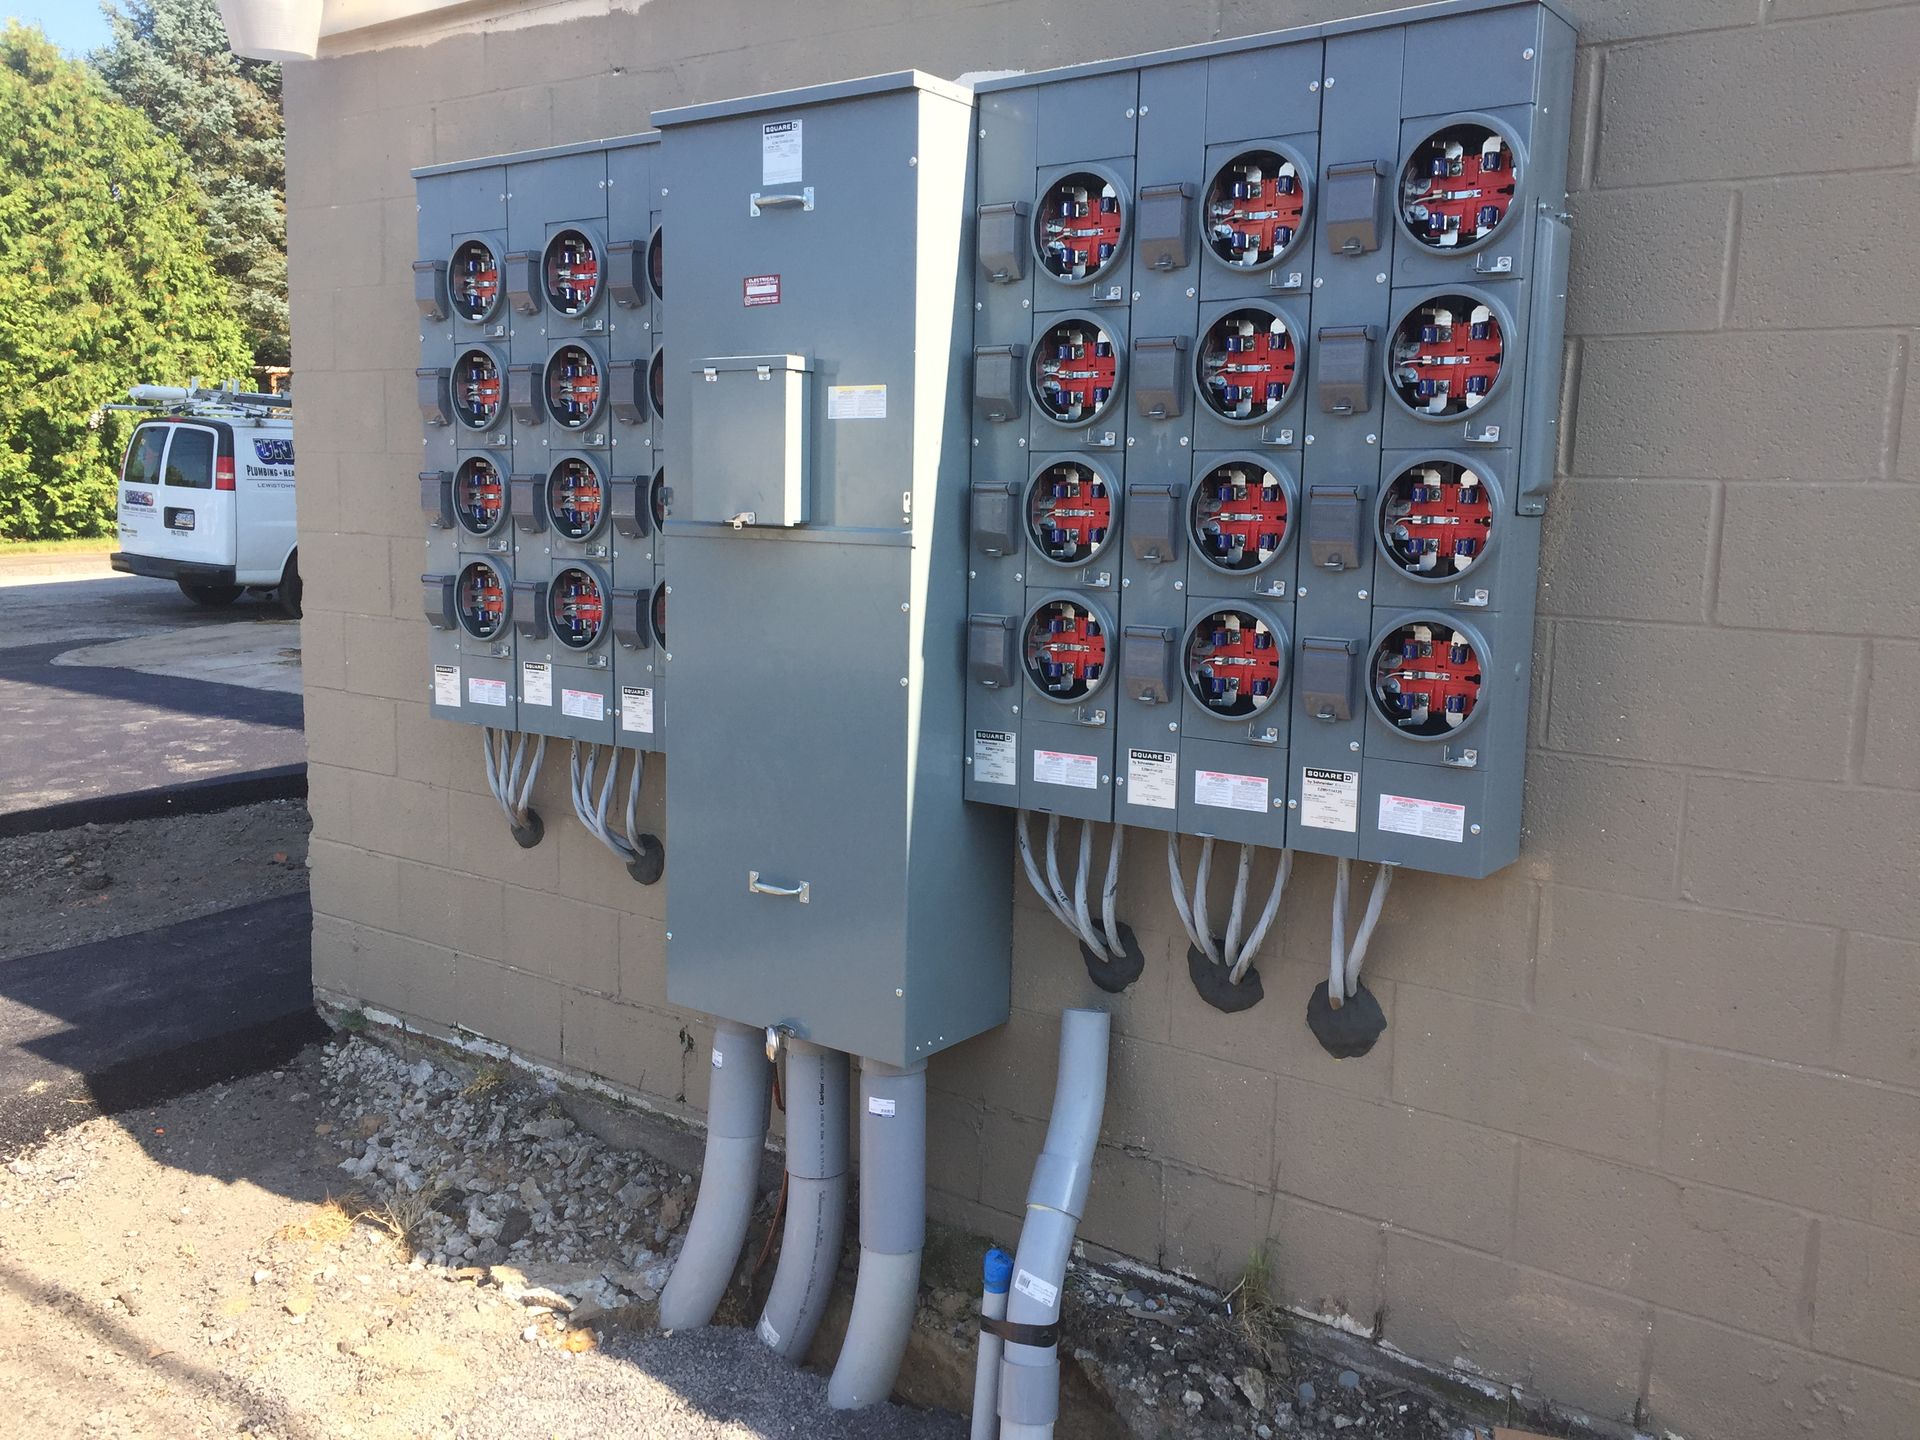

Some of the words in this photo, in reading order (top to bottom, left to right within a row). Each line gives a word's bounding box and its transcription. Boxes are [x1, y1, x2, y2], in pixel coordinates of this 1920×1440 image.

[765, 123, 792, 133] SQUARE
[246, 464, 279, 477] PLUMBING
[526, 662, 545, 671] SQUARE
[624, 688, 645, 696] SQUARE
[977, 731, 1005, 741] SQUARE
[1132, 751, 1164, 761] SQUARE
[1306, 769, 1344, 780] SQUARE
